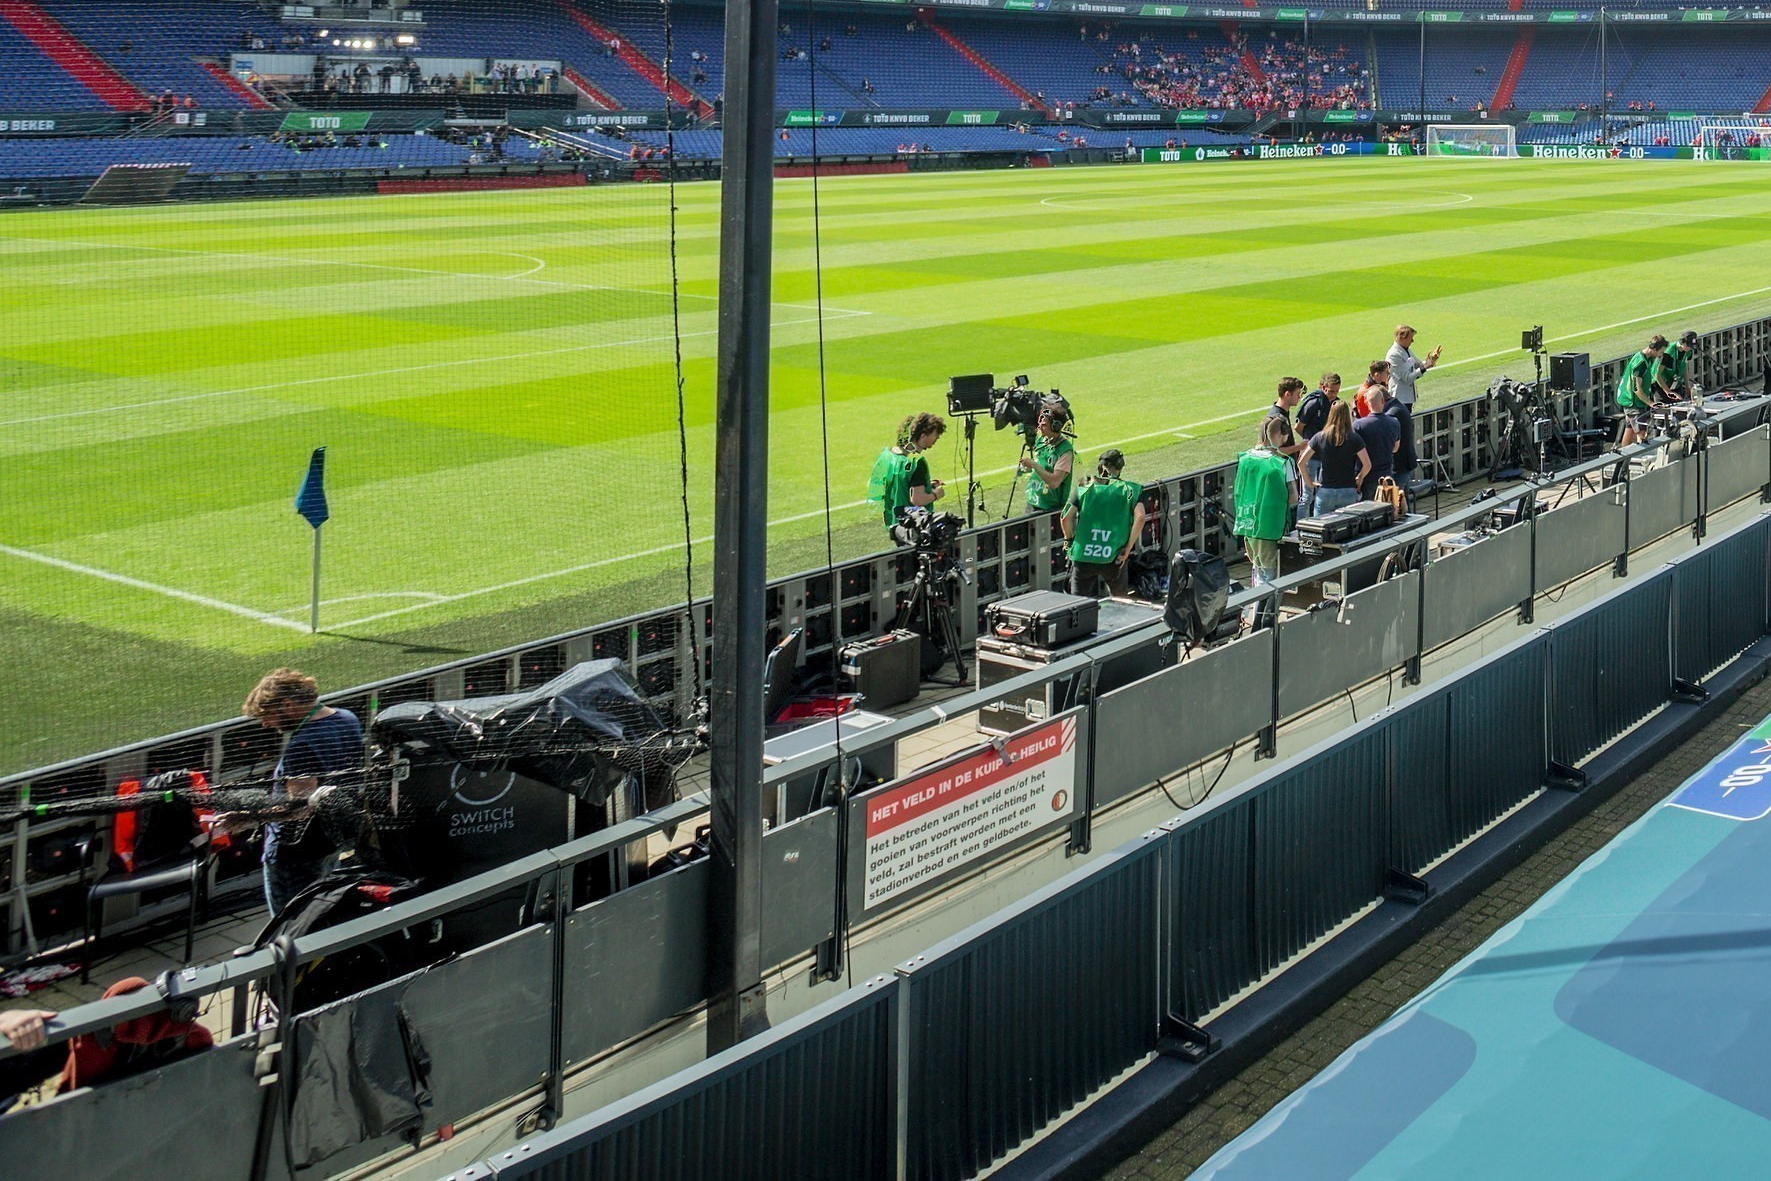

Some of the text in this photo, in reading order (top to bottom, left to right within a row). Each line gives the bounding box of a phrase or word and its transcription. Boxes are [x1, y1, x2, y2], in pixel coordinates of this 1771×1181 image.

[1155, 7, 1172, 15] TOTO
[11, 120, 54, 131] BEKER
[310, 117, 340, 128] TOTO
[963, 115, 980, 123] TOTO
[1160, 151, 1180, 161] TOTO
[1260, 145, 1314, 159] Heineken
[1533, 145, 1607, 159] Heineken
[1091, 529, 1112, 542] TV
[1084, 544, 1112, 558] 520
[872, 801, 900, 823] HET
[902, 787, 936, 809] VELD
[938, 780, 952, 795] IN
[955, 771, 972, 787] DE
[975, 758, 1004, 779] KUIP
[1020, 735, 1056, 759] HEILIG
[450, 805, 514, 827] SWITCH
[870, 771, 1046, 855] Het betreden van het veld en/of het
[450, 818, 514, 837] concepts
[870, 785, 1045, 872] gooien van voorwerpen richting het
[870, 803, 1036, 885] veld, zal bestraft worden met een
[869, 819, 1032, 900] stadionverbod en een geldboete.
